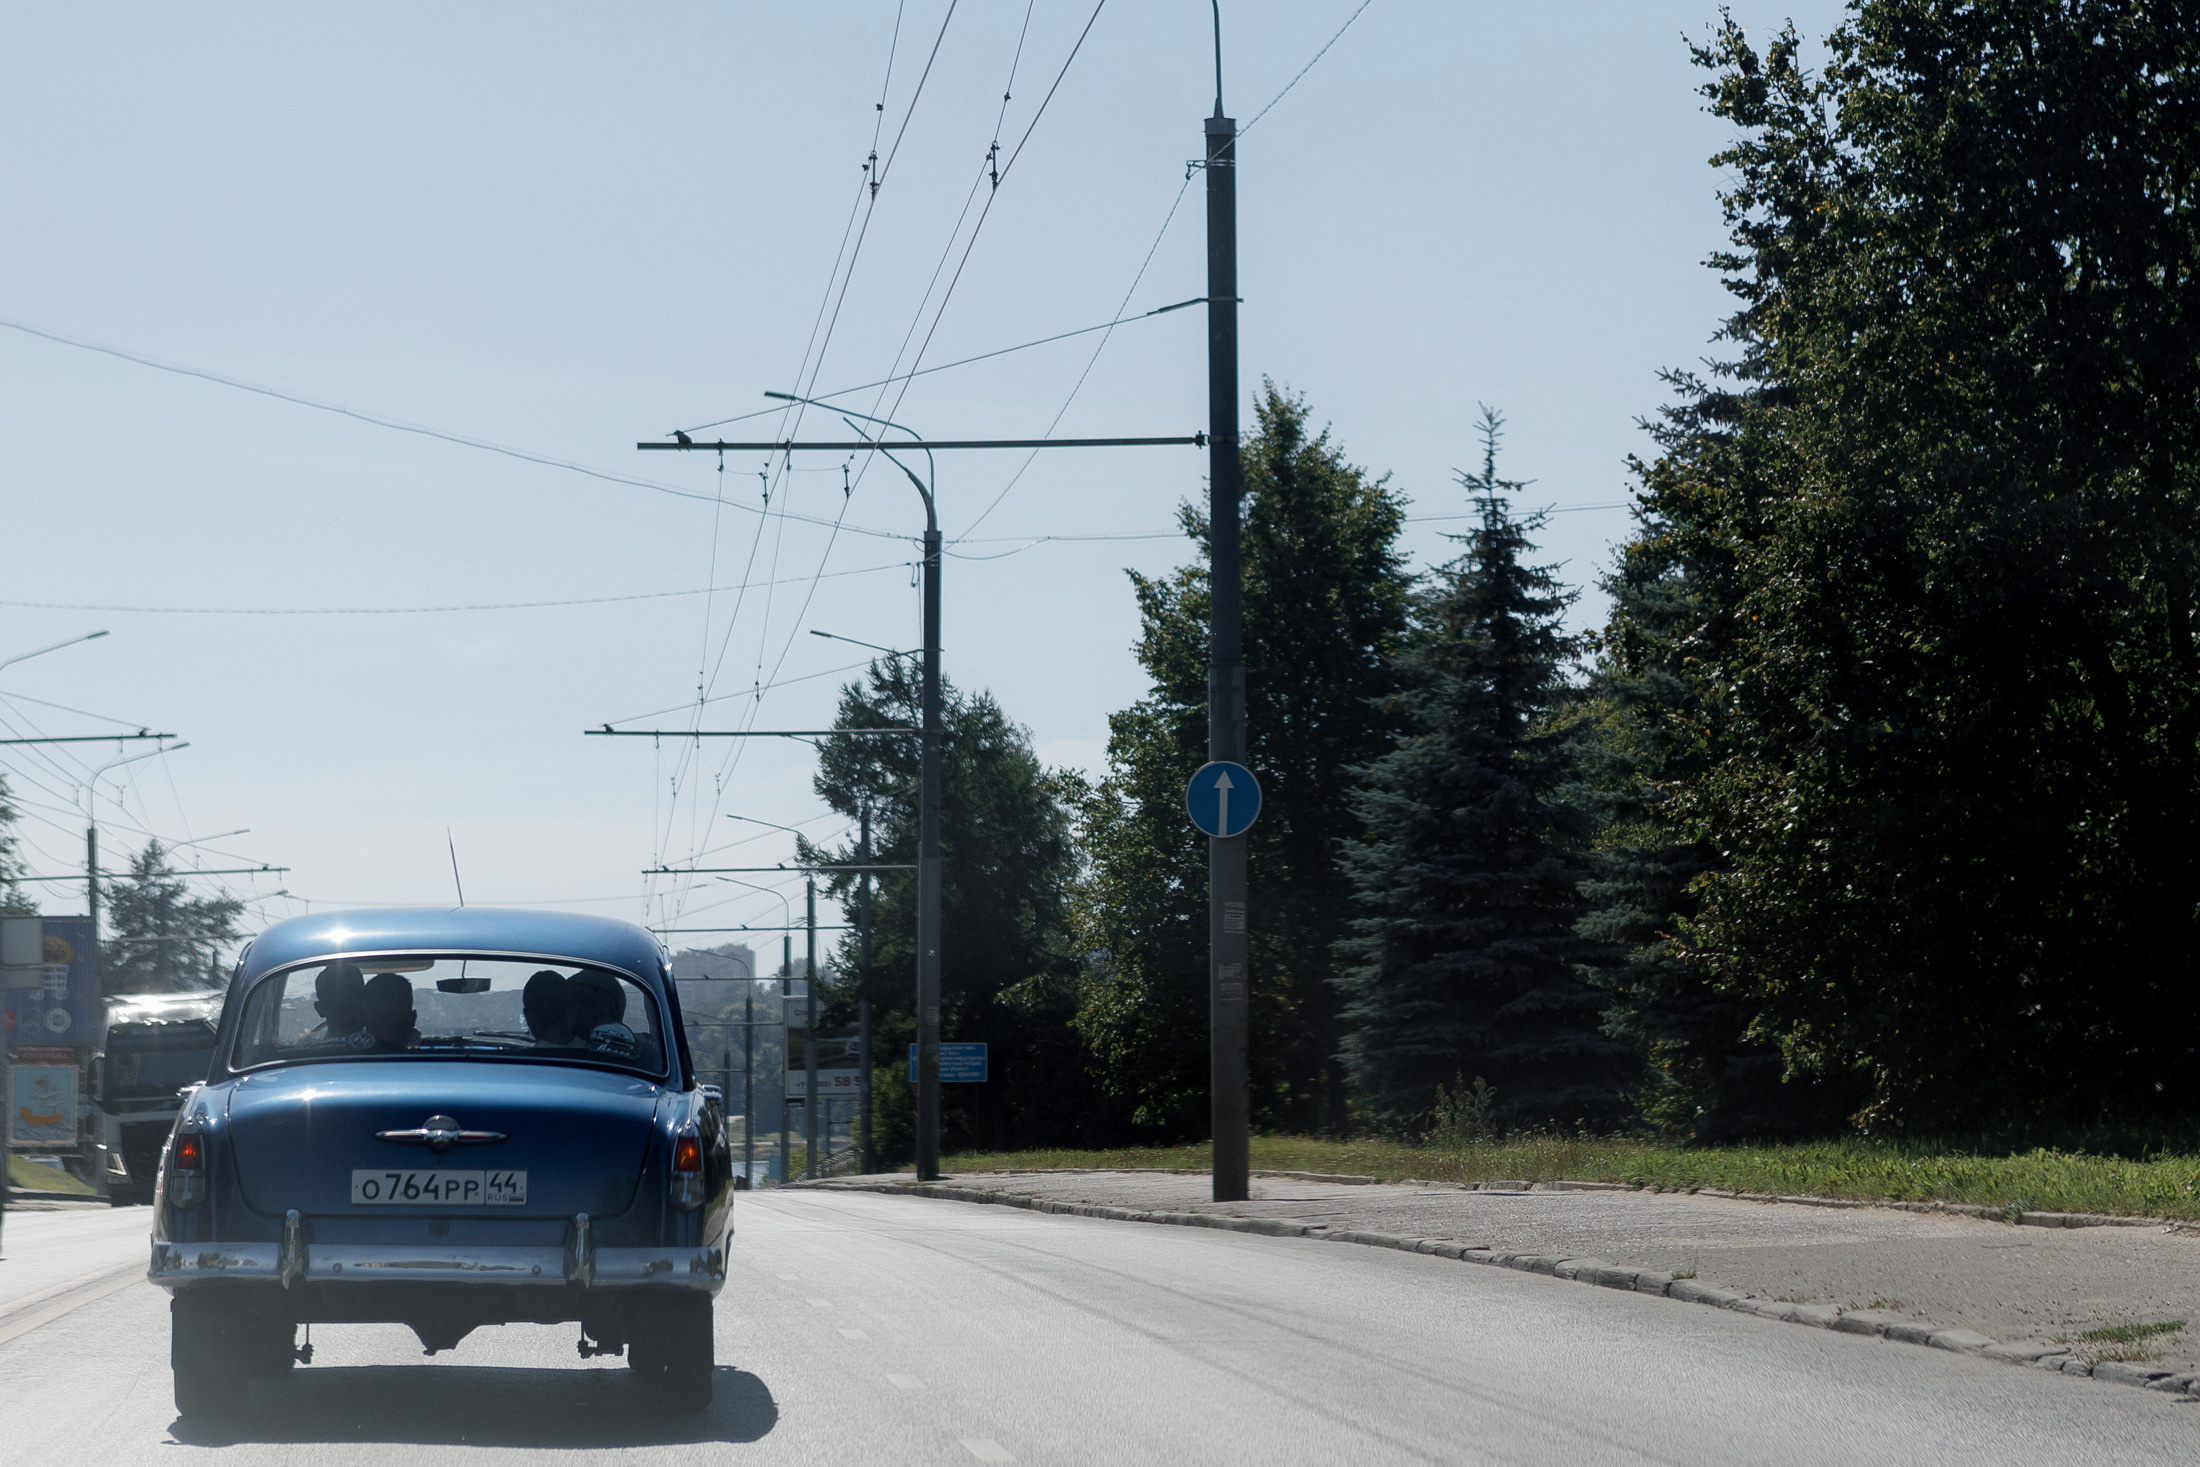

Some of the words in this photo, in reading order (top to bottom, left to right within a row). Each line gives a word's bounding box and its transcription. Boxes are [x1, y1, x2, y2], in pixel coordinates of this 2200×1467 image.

[834, 1076, 851, 1087] 58
[489, 1172, 517, 1192] 44
[487, 1193, 508, 1202] RUS
